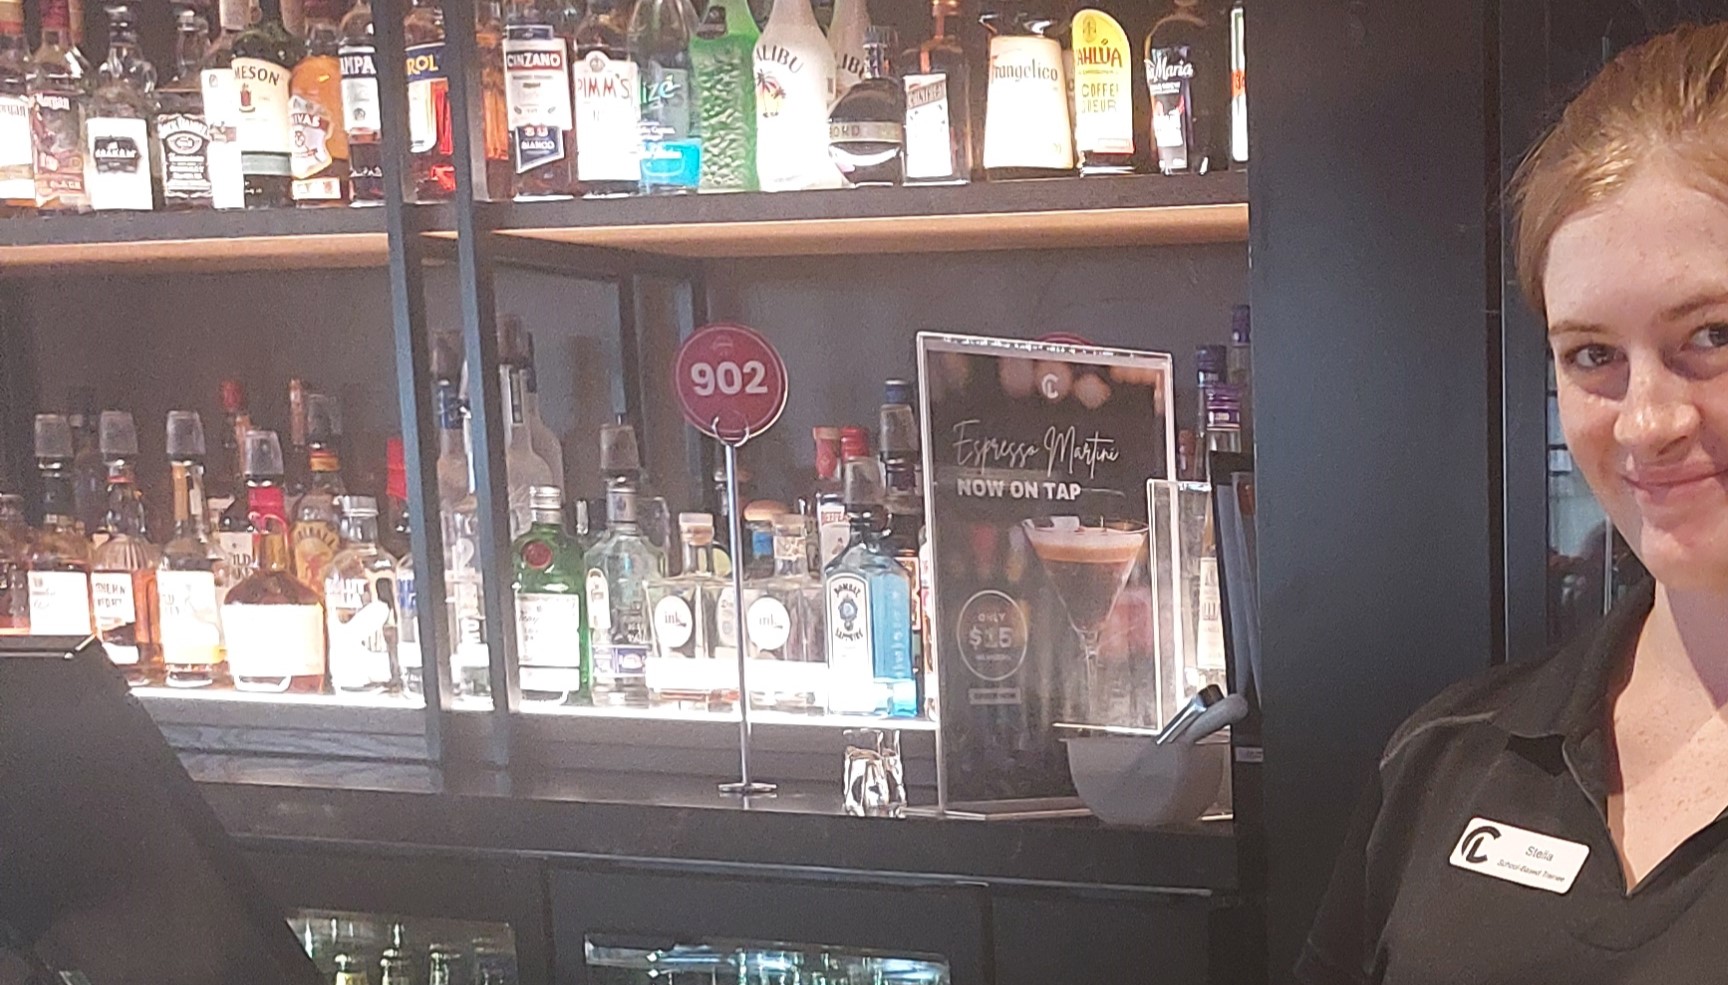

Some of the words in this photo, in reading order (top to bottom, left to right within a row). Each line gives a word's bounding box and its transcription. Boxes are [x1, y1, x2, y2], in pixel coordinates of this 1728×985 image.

[506, 49, 561, 68] CINZANO
[1154, 56, 1194, 80] Maria
[577, 73, 631, 100] PIMM'S
[690, 359, 769, 397] 902
[952, 419, 1039, 475] Espresso
[1043, 425, 1120, 480] Martini
[957, 478, 1006, 499] NOW
[1009, 480, 1039, 499] ON
[1042, 482, 1083, 500] TAP
[833, 582, 862, 596] BOMBAY
[977, 612, 1007, 623] ONLY
[969, 625, 1014, 650] $15
[1525, 845, 1555, 862] Stella
